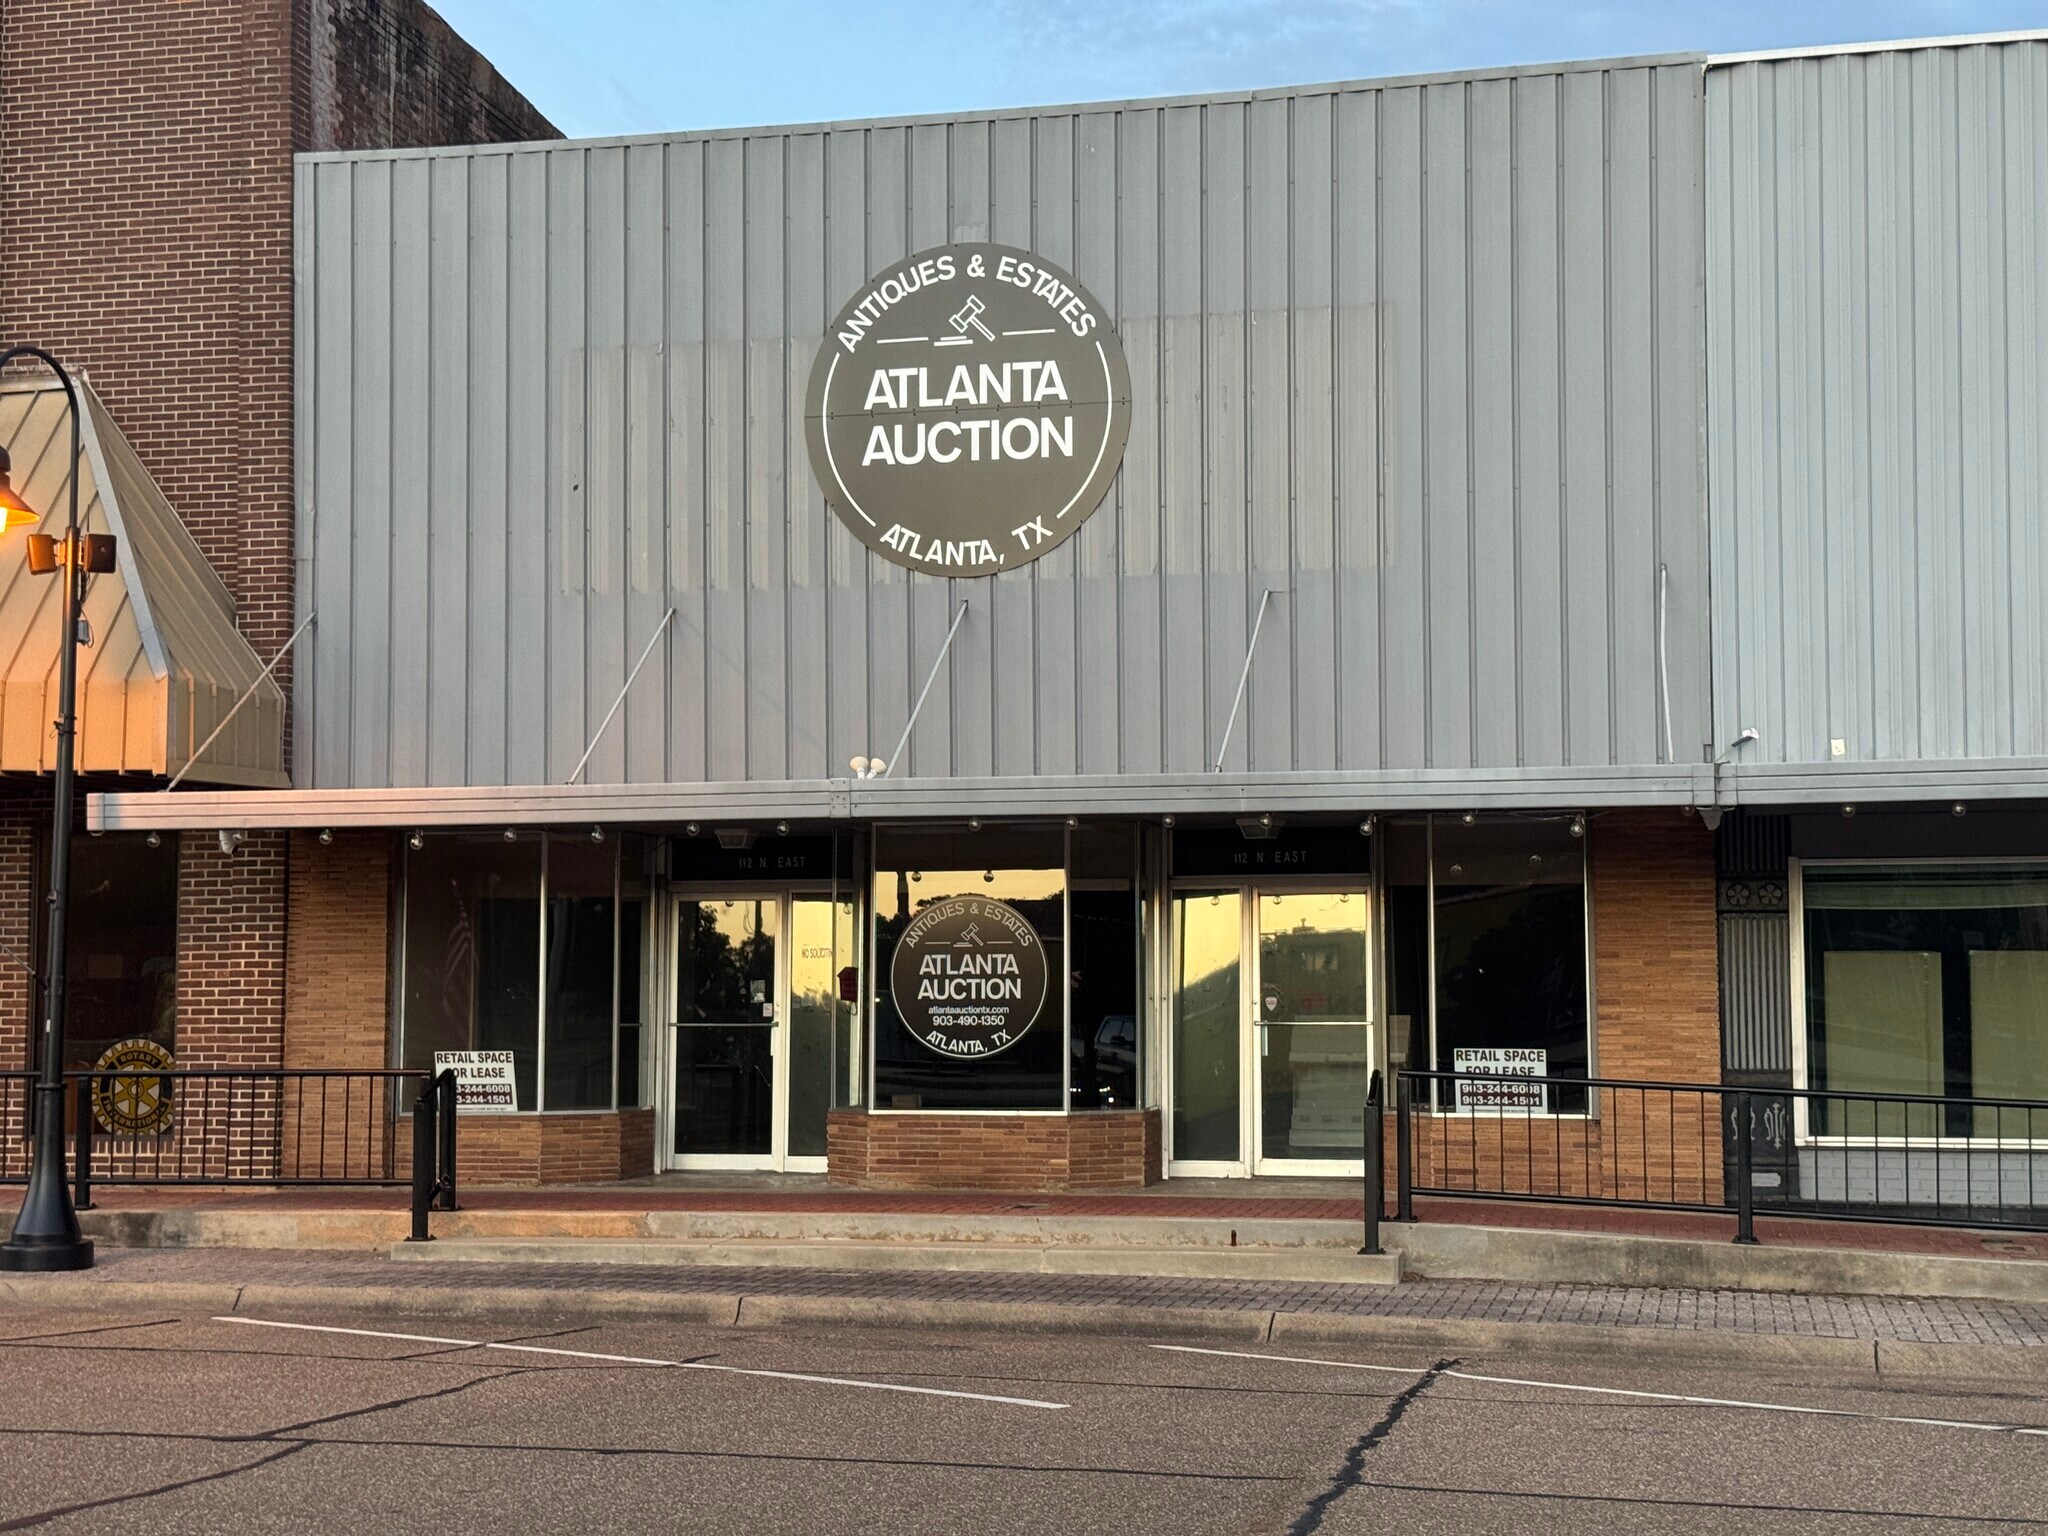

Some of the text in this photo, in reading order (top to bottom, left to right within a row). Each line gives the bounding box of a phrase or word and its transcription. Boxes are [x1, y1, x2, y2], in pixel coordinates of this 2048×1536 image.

[837, 254, 1096, 353] ANTIQUES & ESTATES
[864, 360, 1068, 410] ATLANTA
[861, 416, 1073, 466] AUCTION
[879, 515, 1053, 566] ATLANTA, TX
[739, 857, 753, 869] 112
[777, 856, 805, 868] EAST
[1234, 852, 1248, 864] 112
[1275, 850, 1306, 863] EAST
[905, 902, 1033, 948] ANTIQUES & ESTATES
[919, 953, 1019, 975] ATLANTA
[917, 978, 1021, 1000] AUCTION
[928, 1005, 1009, 1014] atlantaauctiontx.com
[933, 1015, 1005, 1026] 903-490-1350
[926, 1029, 1011, 1053] ATLANTA, TX
[120, 1052, 158, 1065] ROTARY
[436, 1052, 512, 1064] RETAIL SPACE
[1456, 1050, 1544, 1063] RETAIL SPACE
[450, 1067, 505, 1078] OR LEASE
[456, 1084, 511, 1093] 3-244-6008
[1462, 1084, 1540, 1094] 903-244-6008
[456, 1095, 511, 1104] 3-244-1501
[1462, 1095, 1540, 1105] 903-244-1501
